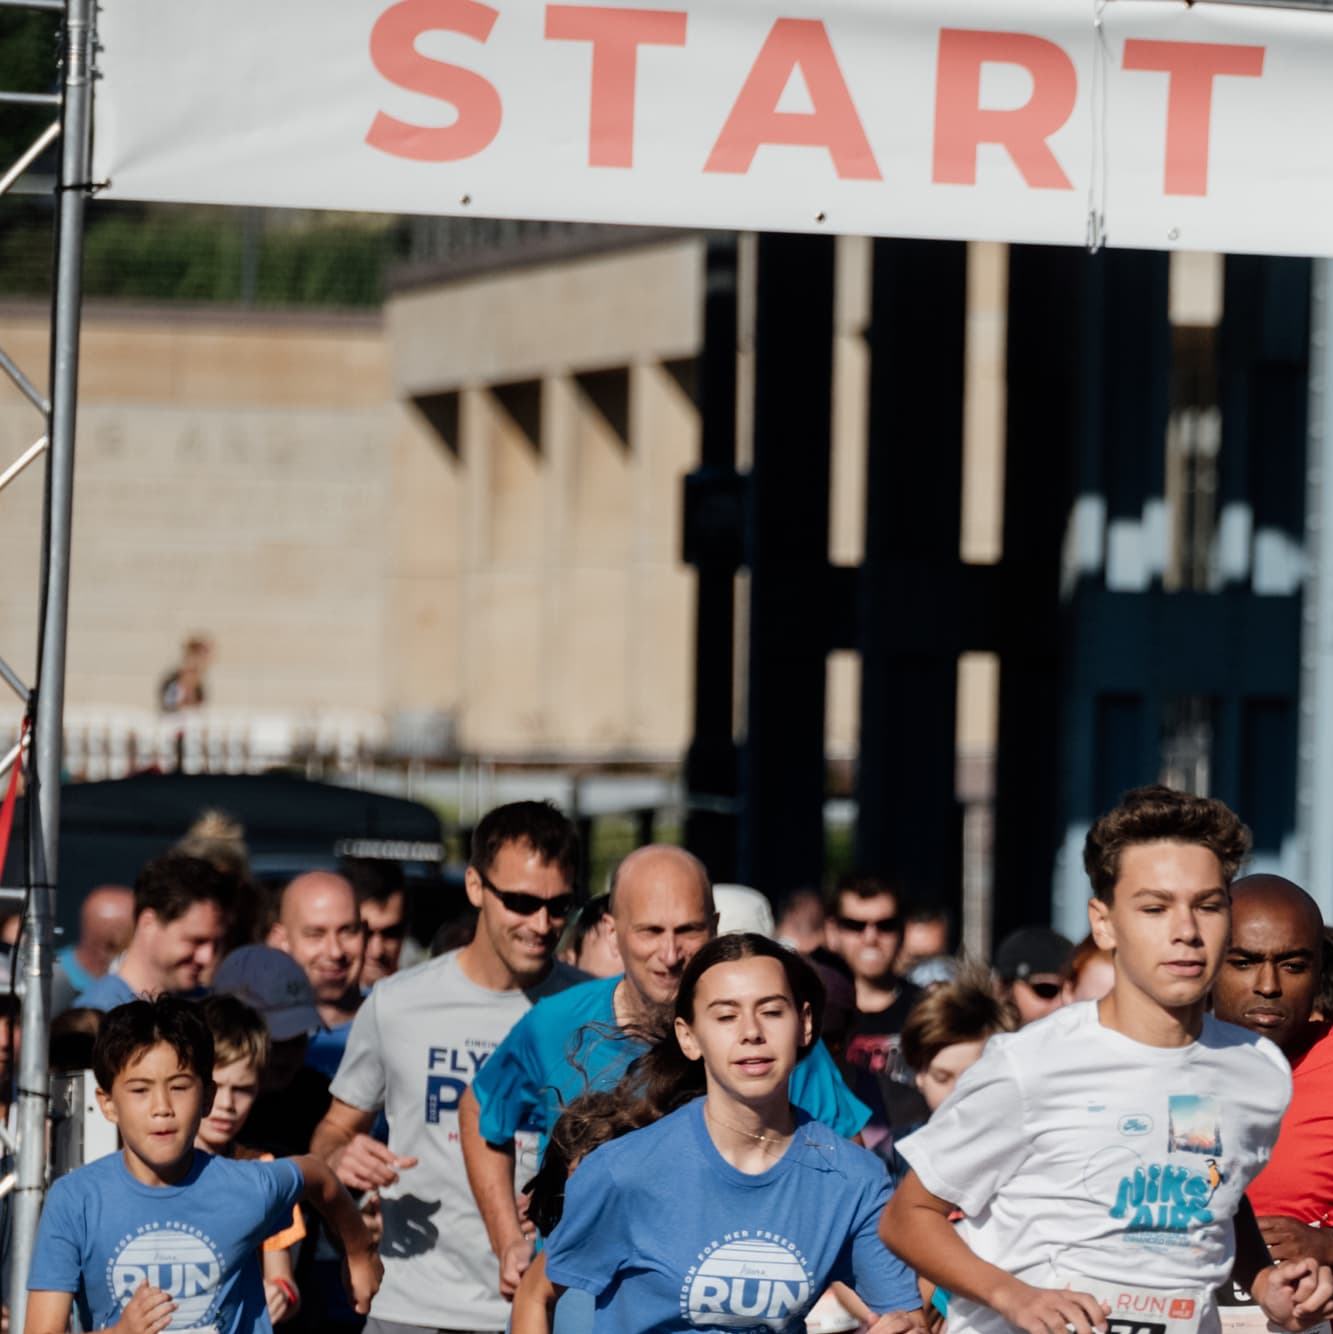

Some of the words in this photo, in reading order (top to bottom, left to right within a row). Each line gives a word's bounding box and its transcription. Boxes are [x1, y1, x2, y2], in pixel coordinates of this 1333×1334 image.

[362, 0, 1267, 198] START
[723, 1229, 749, 1242] HER
[113, 1263, 220, 1308] RUN
[688, 1276, 810, 1318] RUN
[1116, 1293, 1167, 1313] RUN
